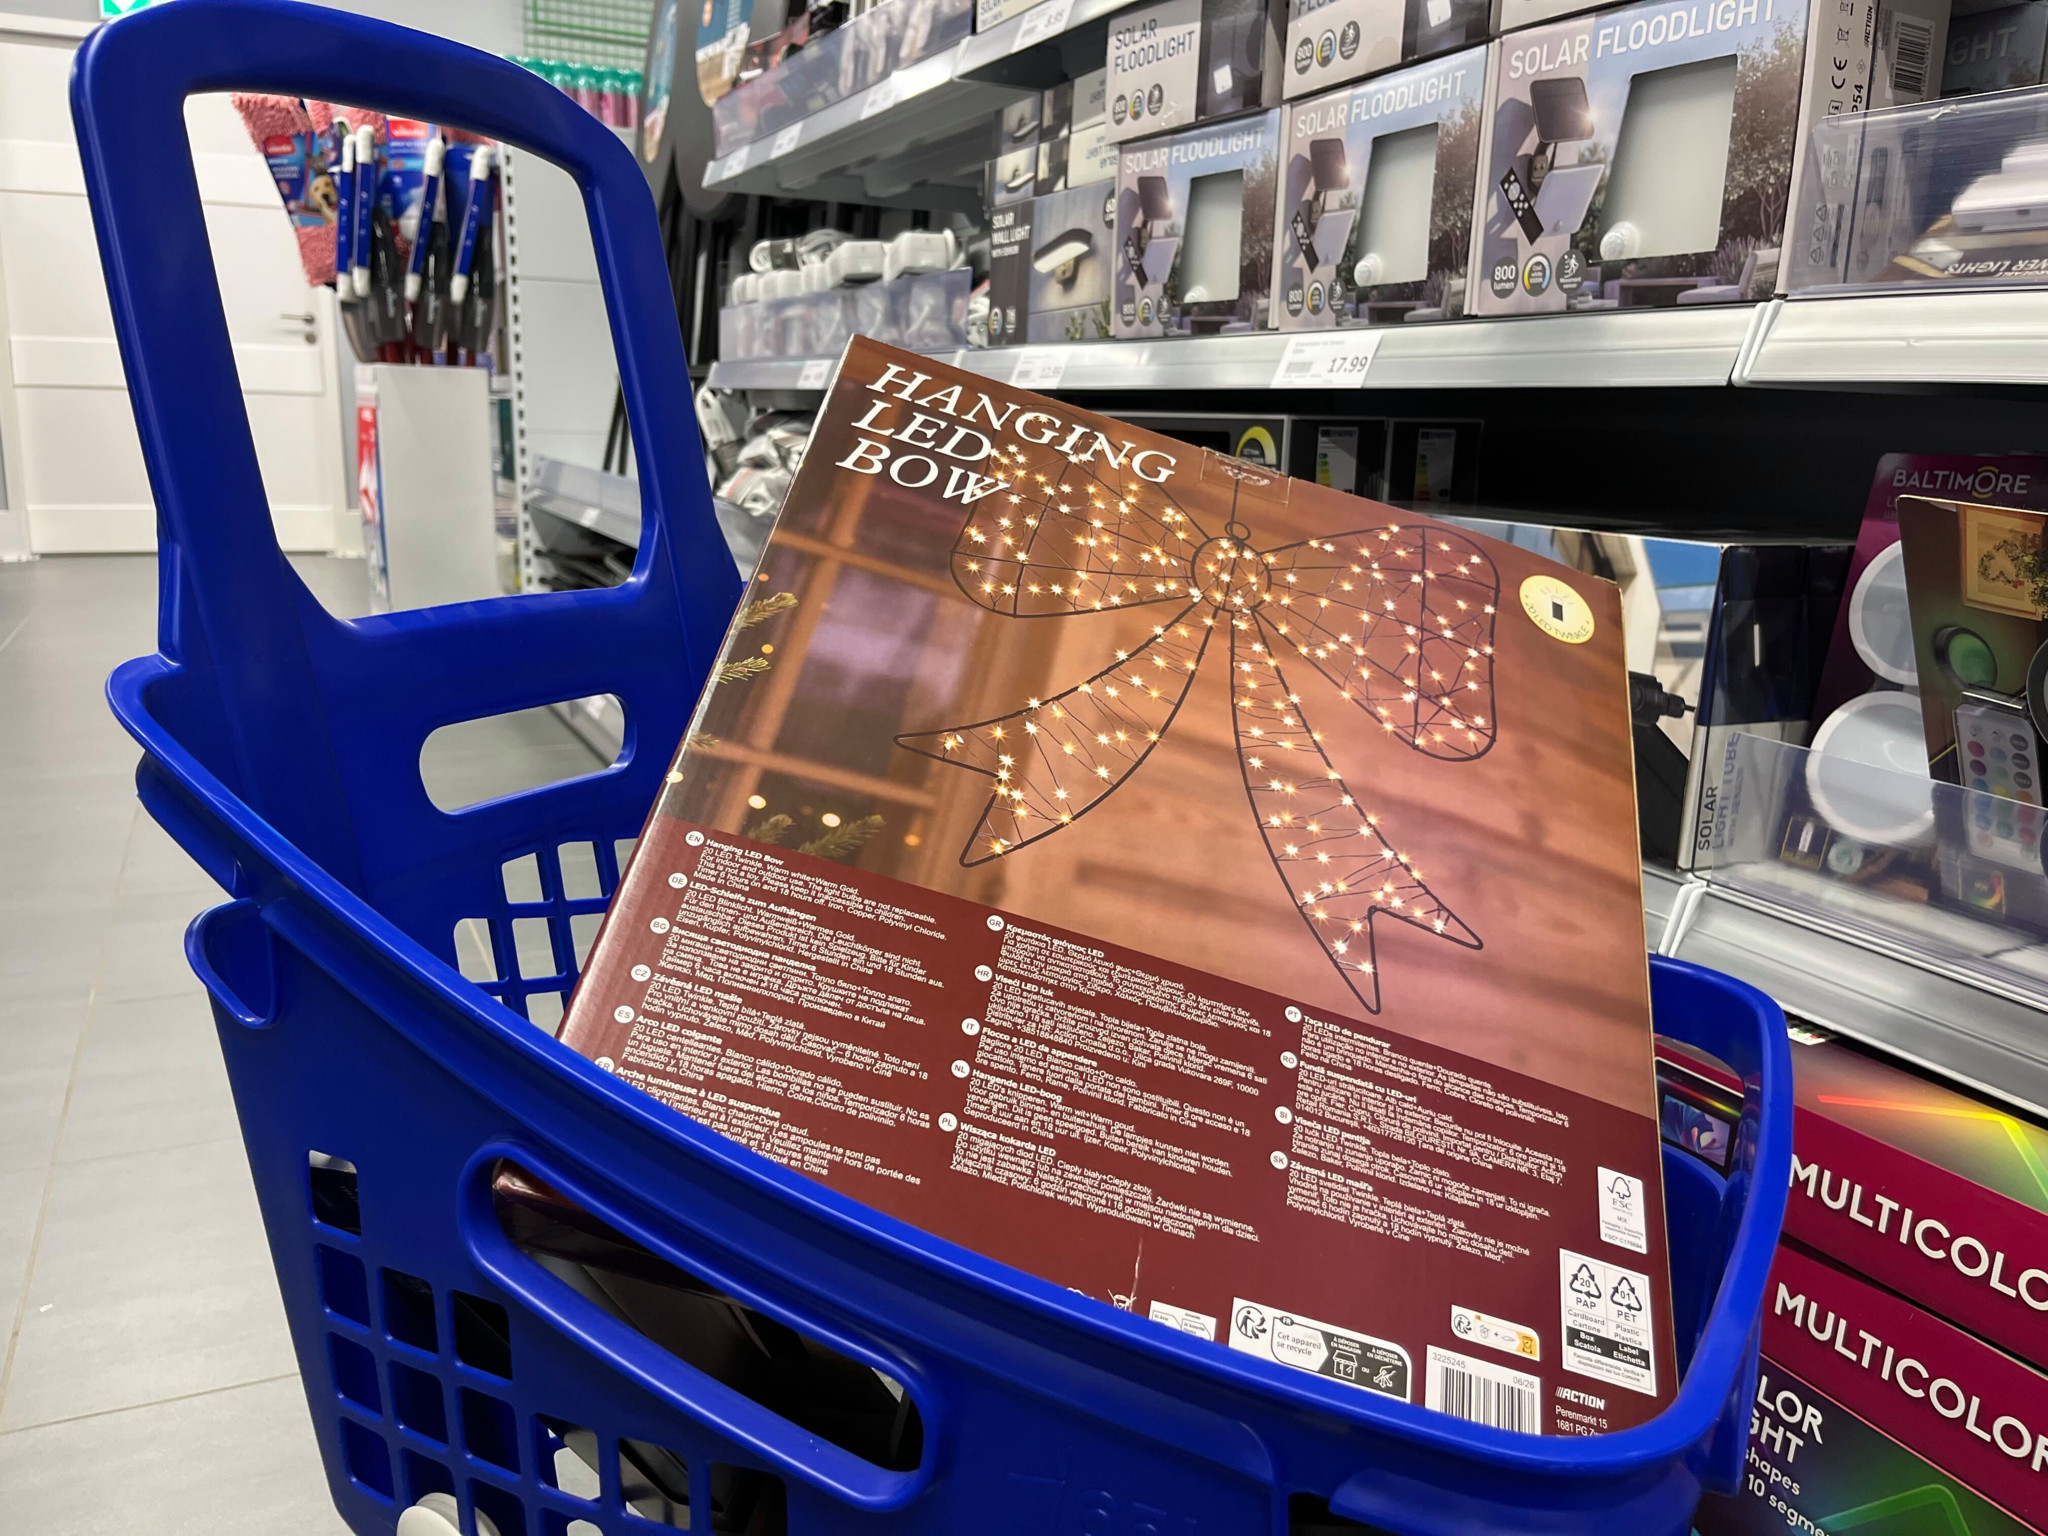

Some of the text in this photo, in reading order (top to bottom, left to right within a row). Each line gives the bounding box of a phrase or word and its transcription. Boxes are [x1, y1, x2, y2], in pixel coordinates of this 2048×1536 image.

[1115, 19, 1157, 50] SOLAR
[1864, 5, 1873, 45] ACTION
[1115, 31, 1195, 75] FLOODLIGHT
[1510, 37, 1590, 79] SOLAR
[1297, 70, 1466, 138] SOLAR FLOODLIGHT
[1125, 147, 1168, 174] SOLAR
[1171, 128, 1265, 165] FLOODLIGHT
[992, 212, 1014, 229] SOLAR
[1494, 265, 1516, 281] 800
[1494, 281, 1515, 291] lumen
[1289, 289, 1303, 303] 800
[1327, 356, 1368, 373] 17.99
[852, 400, 992, 462] LED
[866, 364, 1176, 483] HANGING
[835, 439, 1010, 504] BOW
[1892, 467, 2031, 497] BALTIMORE
[1698, 785, 1718, 851] SOLAR
[688, 834, 784, 865] EN Hanging LED Bow
[988, 918, 1001, 927] GR
[1087, 947, 1104, 957] LED
[693, 983, 713, 995] LED
[976, 968, 989, 977] HR
[1021, 981, 1038, 992] LED
[1324, 1022, 1340, 1032] LED
[1018, 1037, 1036, 1048] LED
[954, 1064, 965, 1073] NL
[1282, 1055, 1294, 1064] RO
[941, 1117, 952, 1126] PL
[1037, 1144, 1056, 1156] LED
[1323, 1124, 1340, 1135] LED
[1272, 1155, 1284, 1164] SK
[1327, 1171, 1344, 1182] LED
[1612, 1197, 1631, 1210] FSC
[1789, 1154, 2048, 1311] MULTICOLO
[1579, 1277, 1630, 1300] 20 01
[1567, 1308, 1639, 1336] Cardboard Plastic
[1575, 1296, 1636, 1322] PAP PET
[1277, 1331, 1321, 1350] Cet appareil
[1572, 1319, 1642, 1346] Cartone Plastica
[1579, 1331, 1638, 1355] Box Label
[1284, 1343, 1312, 1356] recycle
[1573, 1338, 1645, 1366] Scatola Etichetta
[1432, 1351, 1534, 1389] 3225245 06/26
[1560, 1386, 1604, 1410] ACTION
[1555, 1404, 1607, 1429] Perenmarkt 15
[1556, 1418, 1573, 1432] 1681
[1575, 1423, 1587, 1436] PG
[1748, 1474, 1830, 1536] 10 segme
